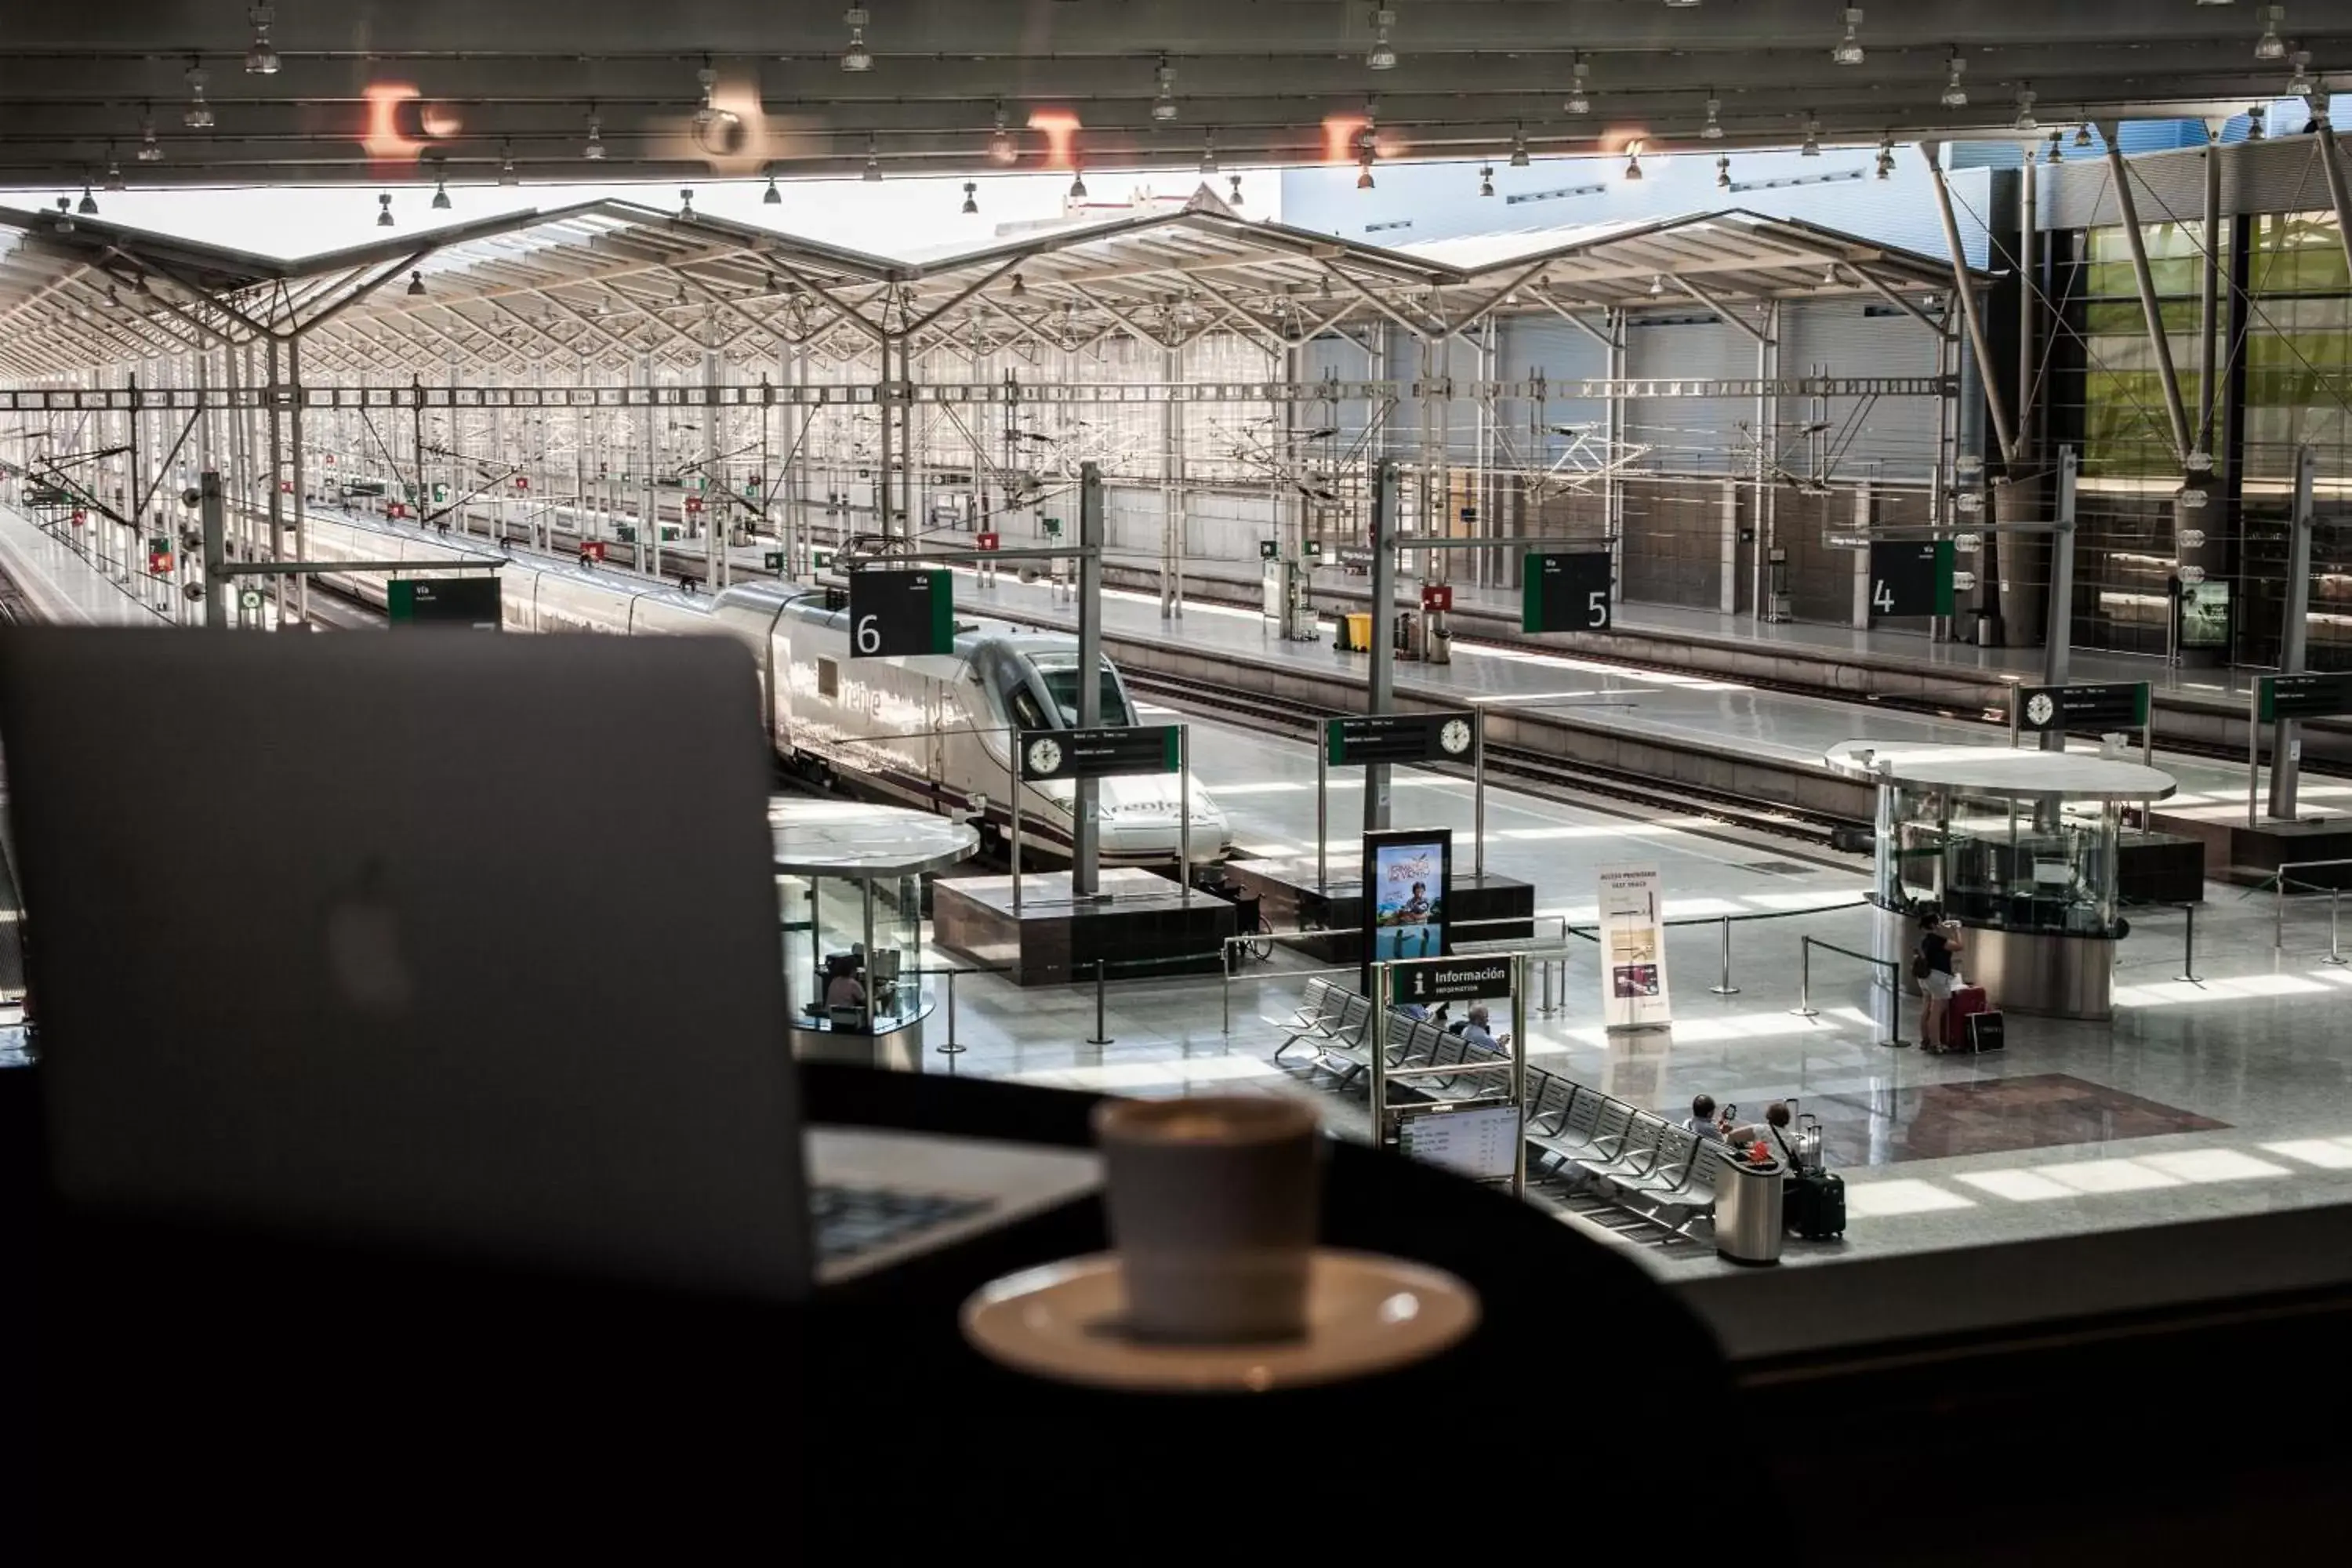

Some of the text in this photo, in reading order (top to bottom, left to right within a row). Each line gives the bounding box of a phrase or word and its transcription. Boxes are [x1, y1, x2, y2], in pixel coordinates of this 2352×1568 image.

[1588, 590, 1607, 629] 5
[1873, 579, 1895, 613] 4
[856, 614, 881, 654] 6
[1435, 966, 1505, 985] Información
